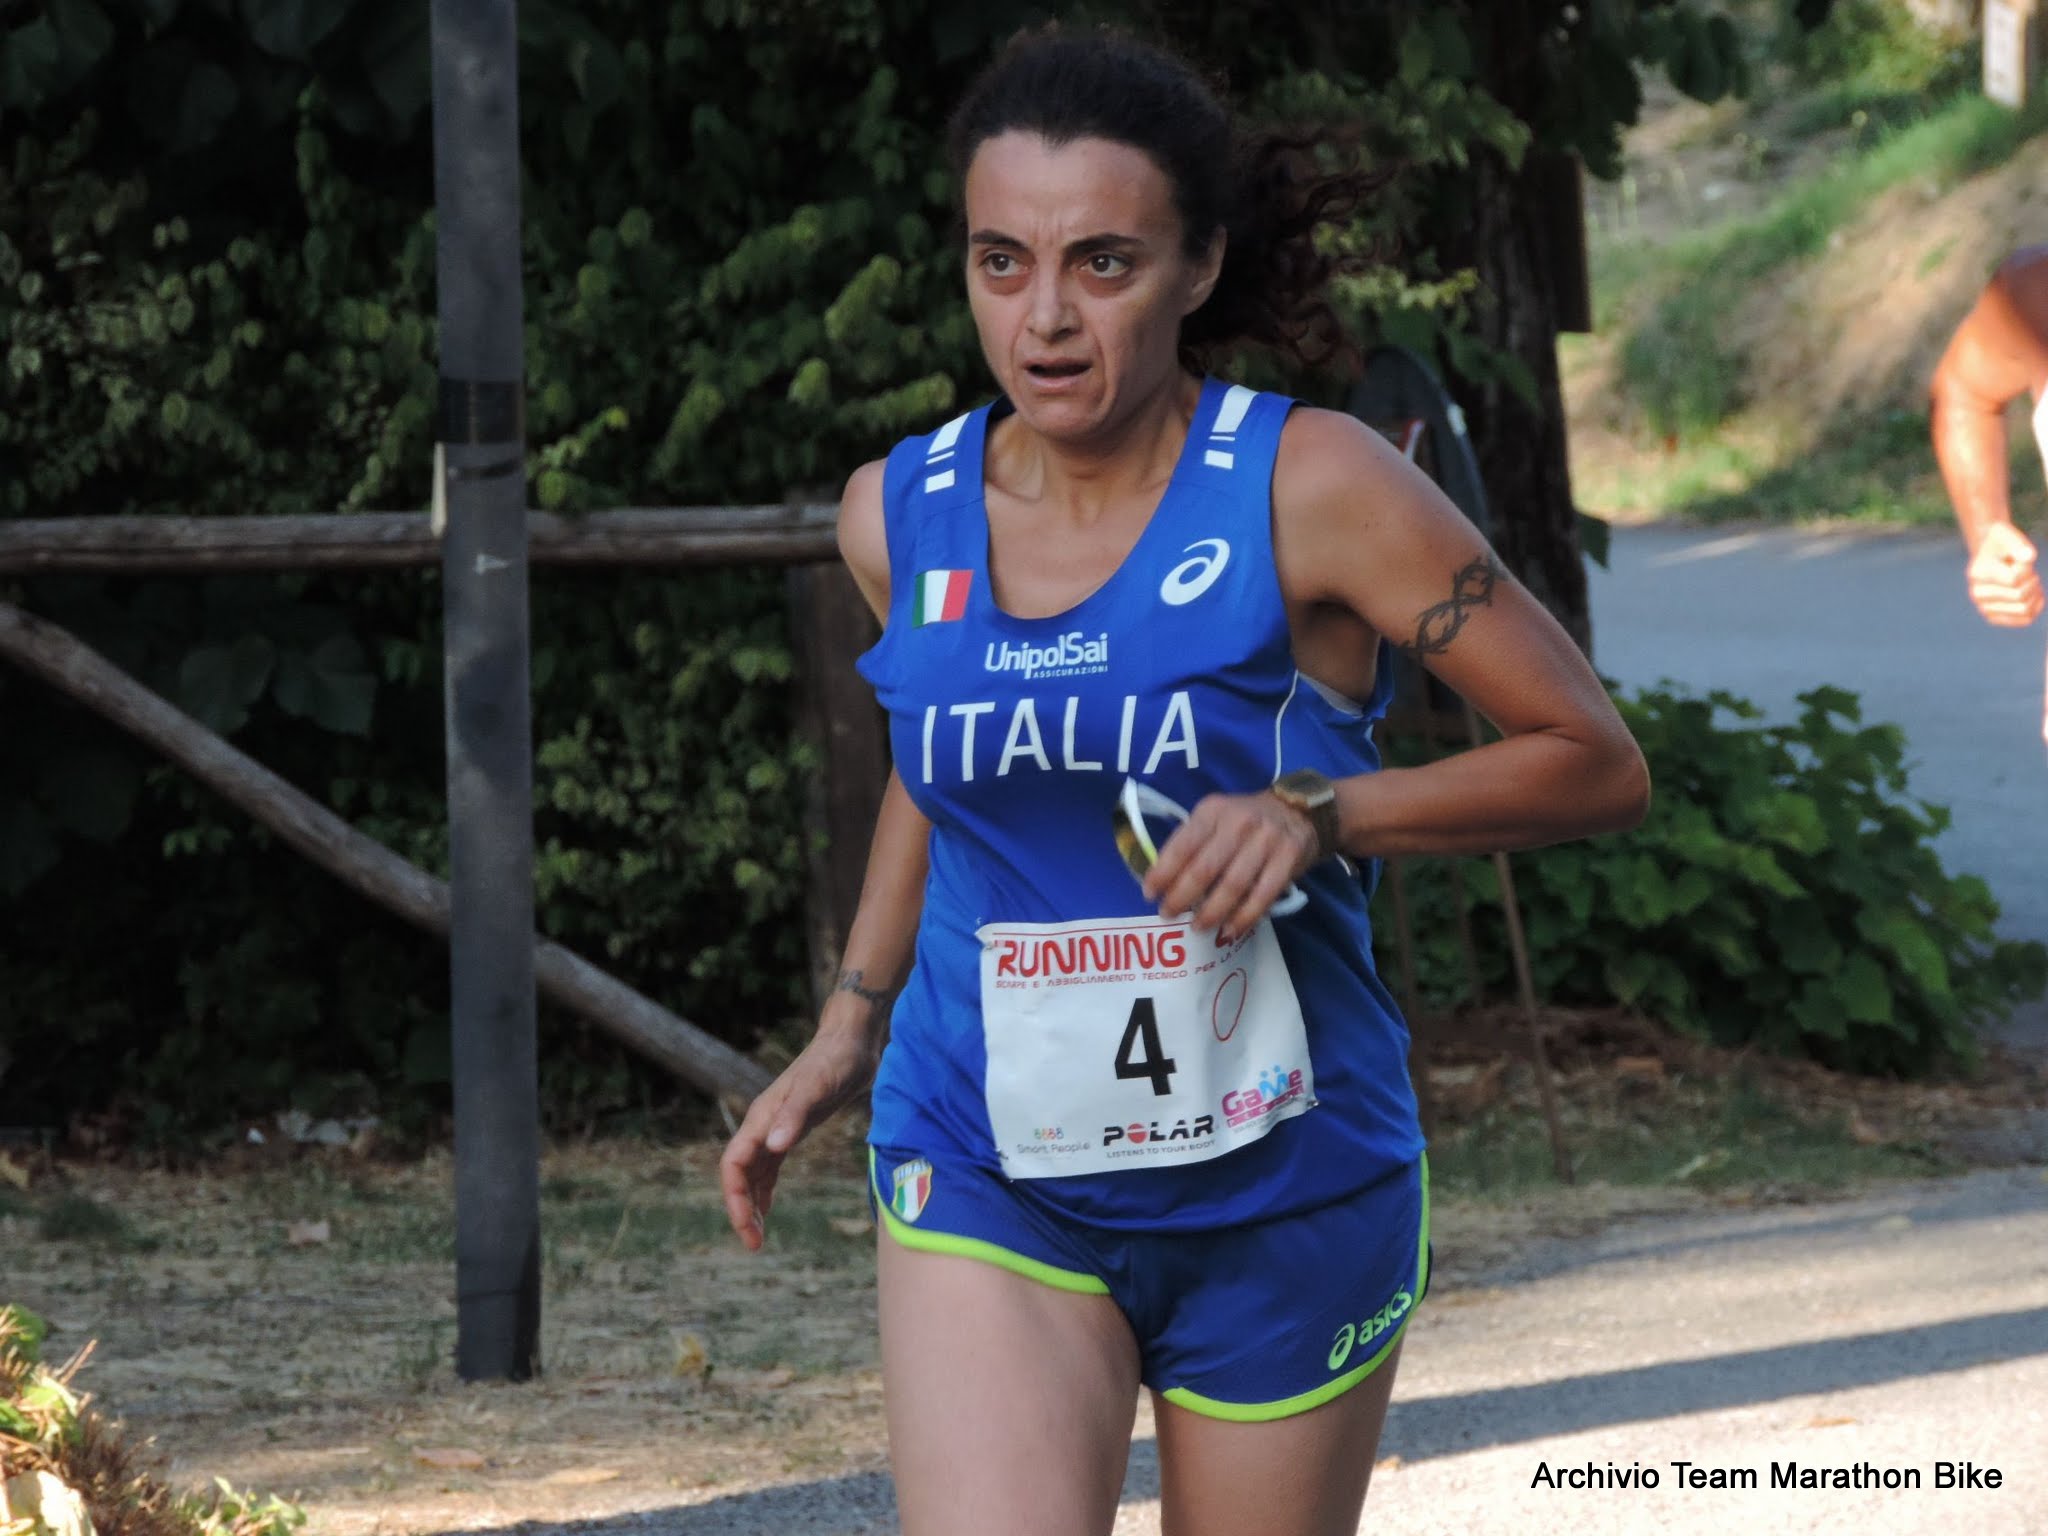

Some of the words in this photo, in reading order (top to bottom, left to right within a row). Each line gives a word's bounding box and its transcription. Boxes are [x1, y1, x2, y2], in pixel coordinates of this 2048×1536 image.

[984, 631, 1109, 680] UnipolSai
[1032, 665, 1109, 679] ASSICURAZIONI
[921, 690, 1201, 785] ITALIA
[997, 930, 1187, 978] RUNNING
[1142, 969, 1189, 982] TECNICO
[1113, 996, 1178, 1098] 4
[1103, 1114, 1215, 1147] POLAR
[1106, 1148, 1146, 1159] LISTENS
[1147, 1146, 1160, 1156] TO
[1161, 1144, 1187, 1155] YOUR
[1189, 1138, 1217, 1152] BODY
